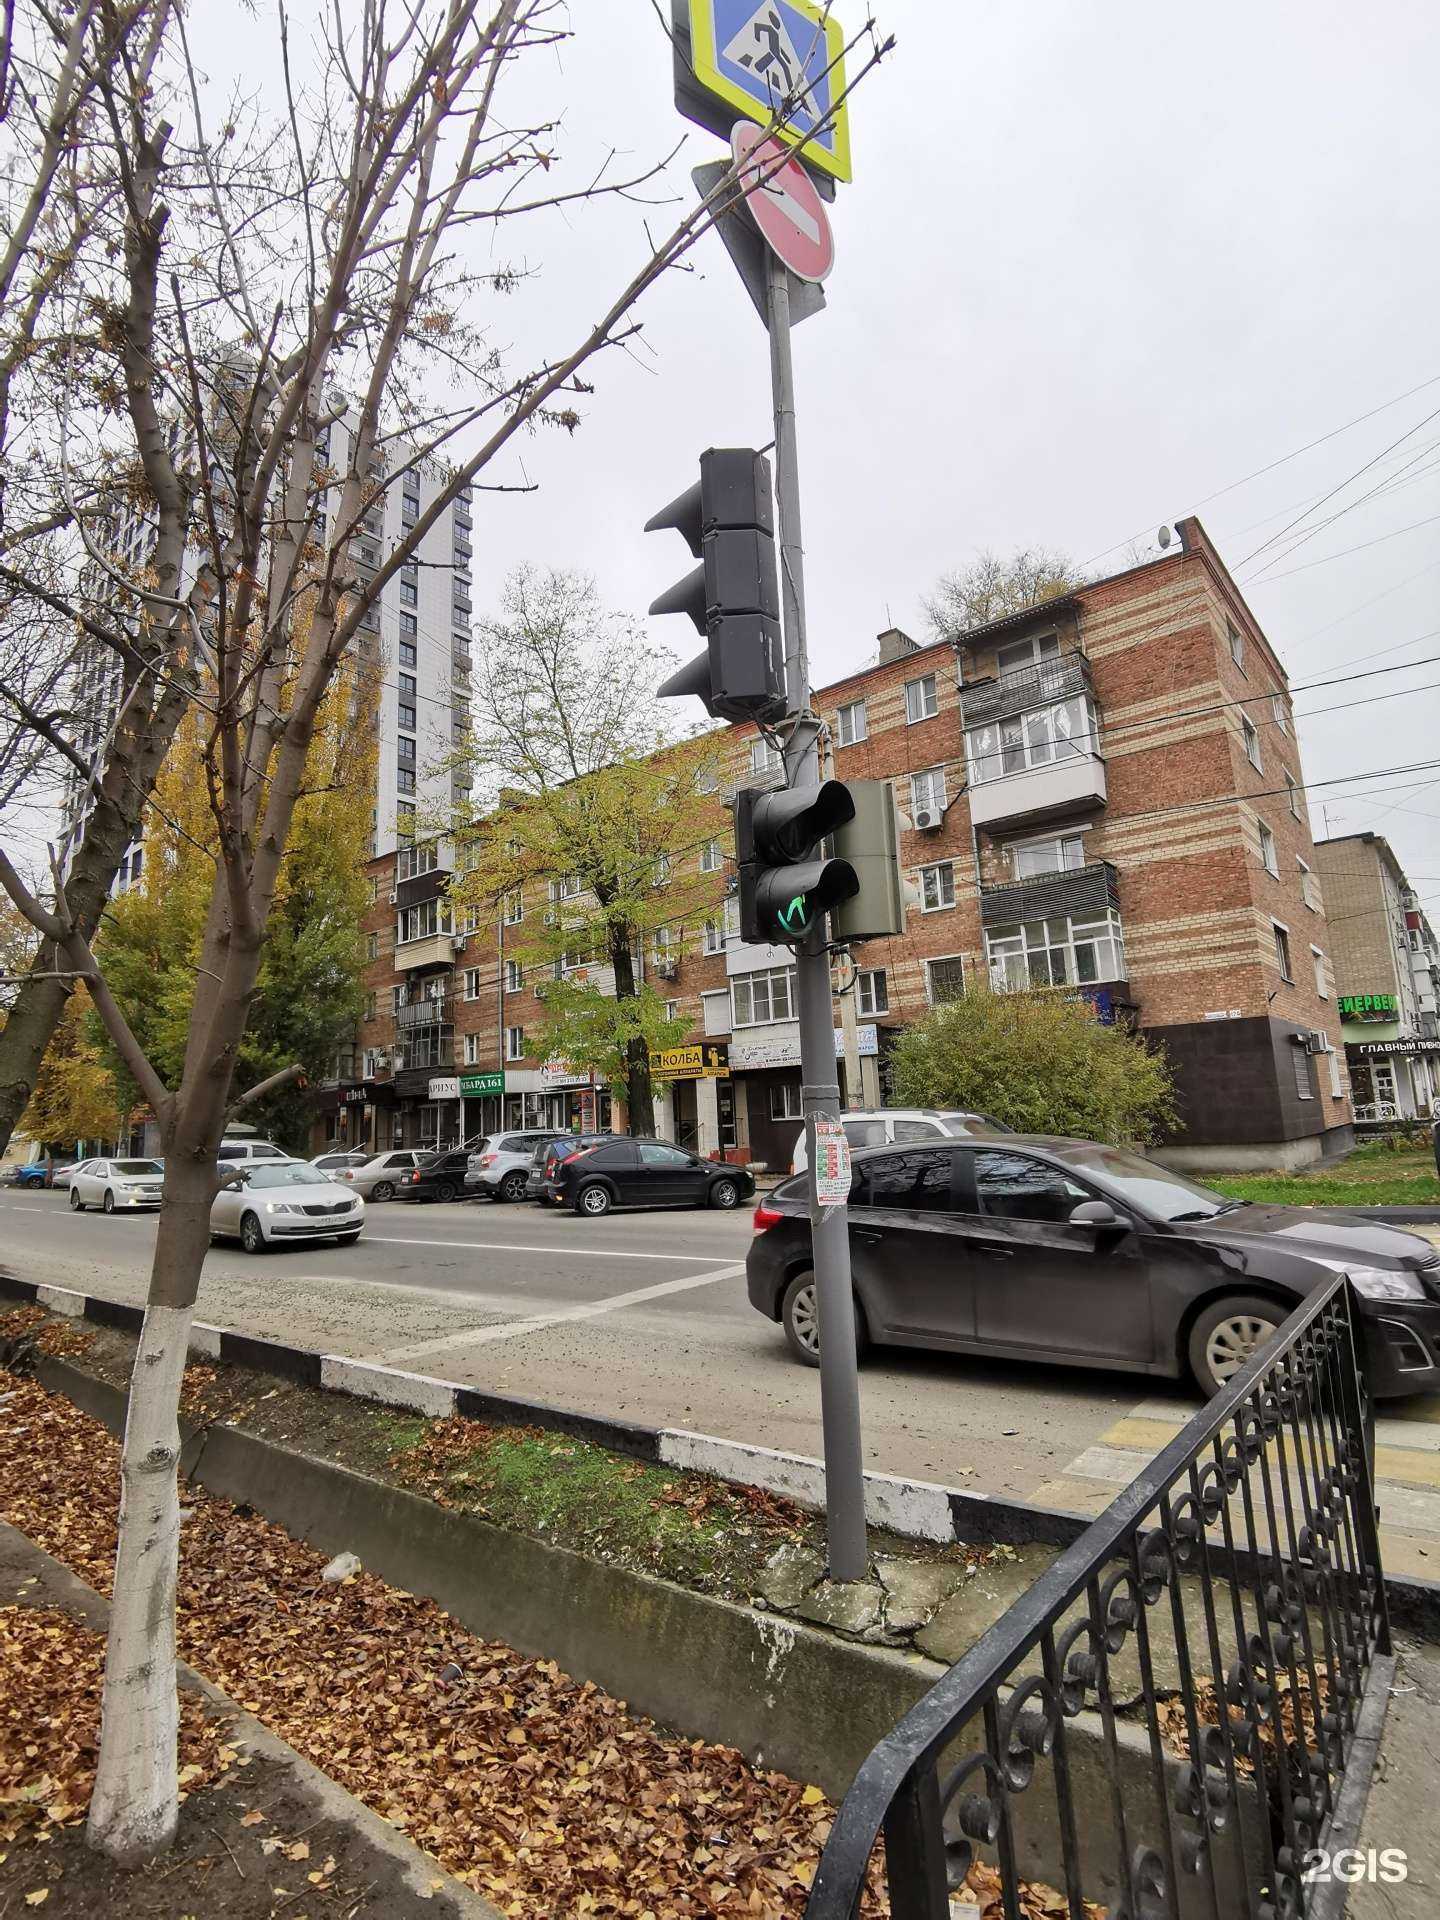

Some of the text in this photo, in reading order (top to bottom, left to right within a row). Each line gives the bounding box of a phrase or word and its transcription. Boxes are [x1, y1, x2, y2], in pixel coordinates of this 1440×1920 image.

[1360, 1041, 1415, 1053] ГЛАВНЫЙ
[662, 1052, 700, 1066] КОЛБА
[487, 1079, 502, 1087] 161
